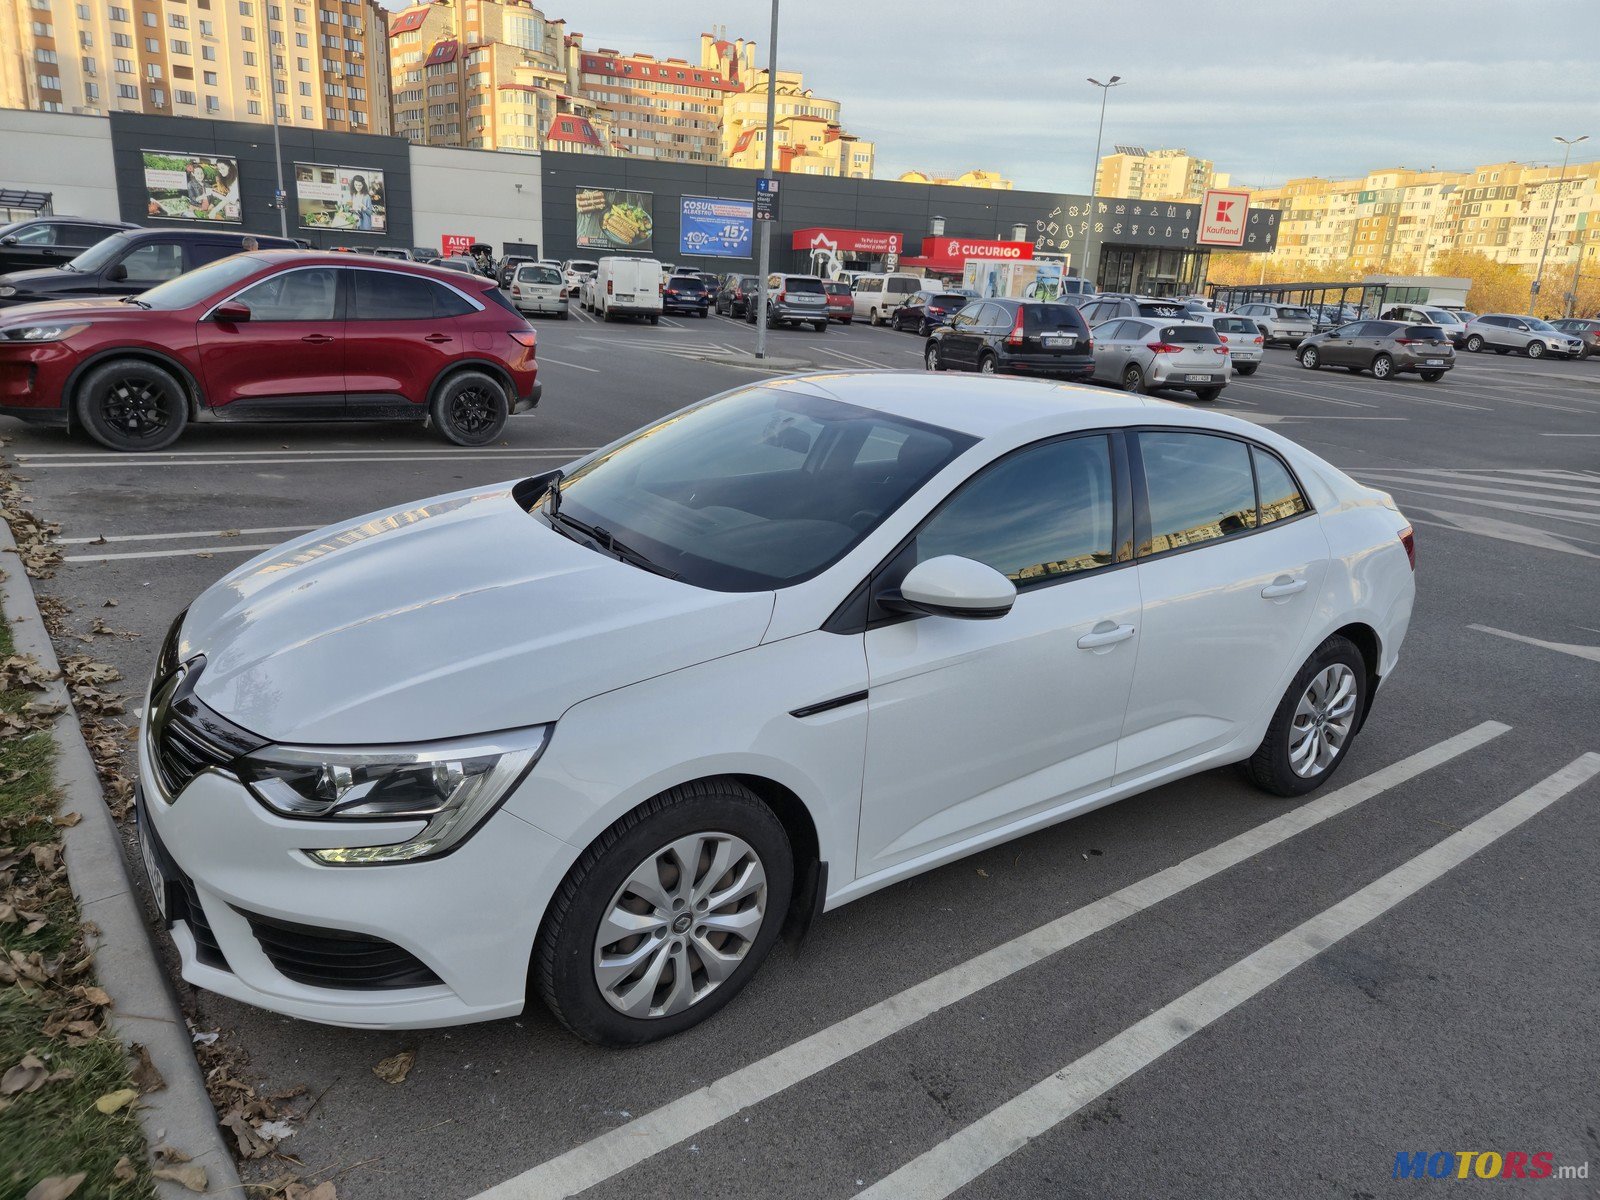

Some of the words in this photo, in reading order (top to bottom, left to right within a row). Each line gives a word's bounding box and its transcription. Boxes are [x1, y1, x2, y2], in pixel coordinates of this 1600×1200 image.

[1206, 226, 1239, 235] Kaufland
[448, 236, 470, 246] AICI
[962, 244, 1021, 258] CUCURIGO
